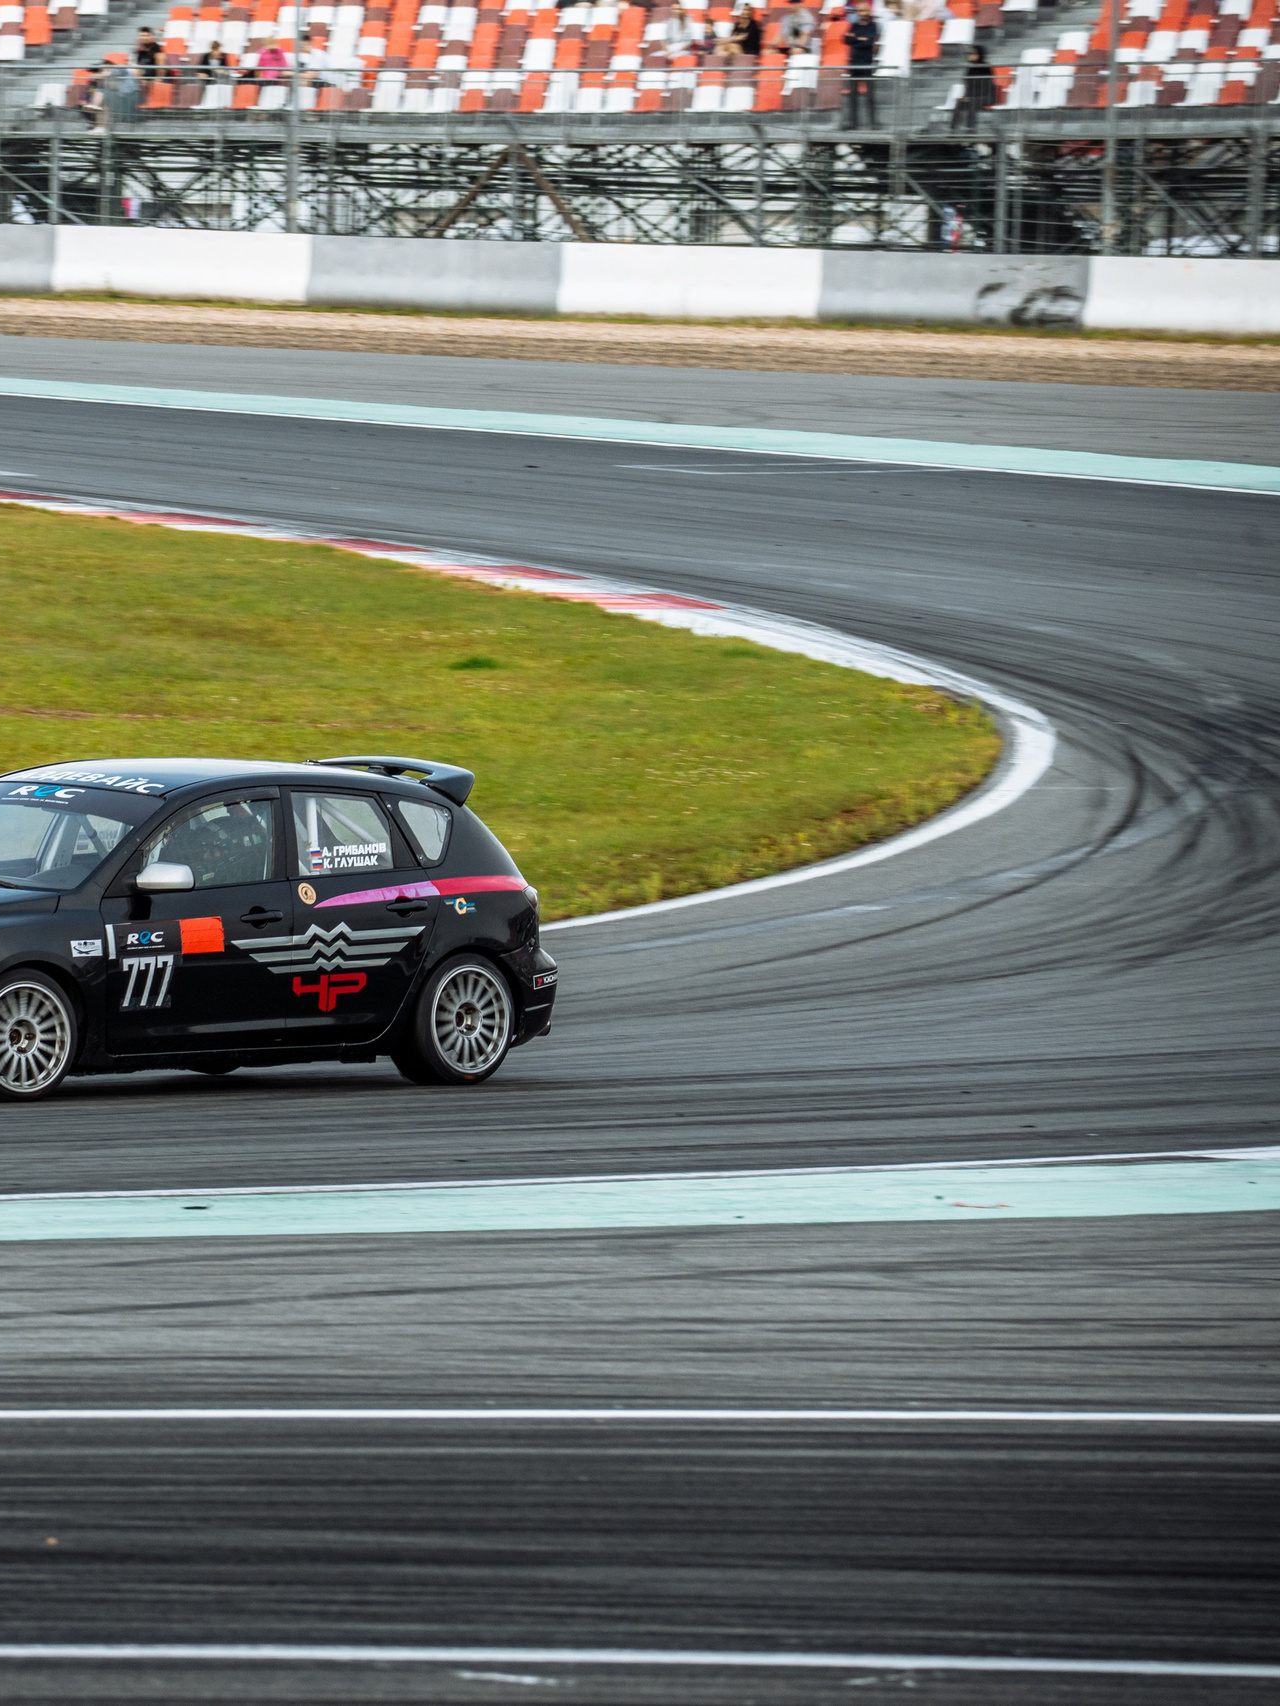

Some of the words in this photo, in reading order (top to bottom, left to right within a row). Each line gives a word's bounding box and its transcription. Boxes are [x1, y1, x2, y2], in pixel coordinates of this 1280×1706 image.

[333, 842, 387, 857] ГРИБАНОВ
[334, 855, 379, 868] ГЛУШАК
[122, 954, 174, 1007] 777
